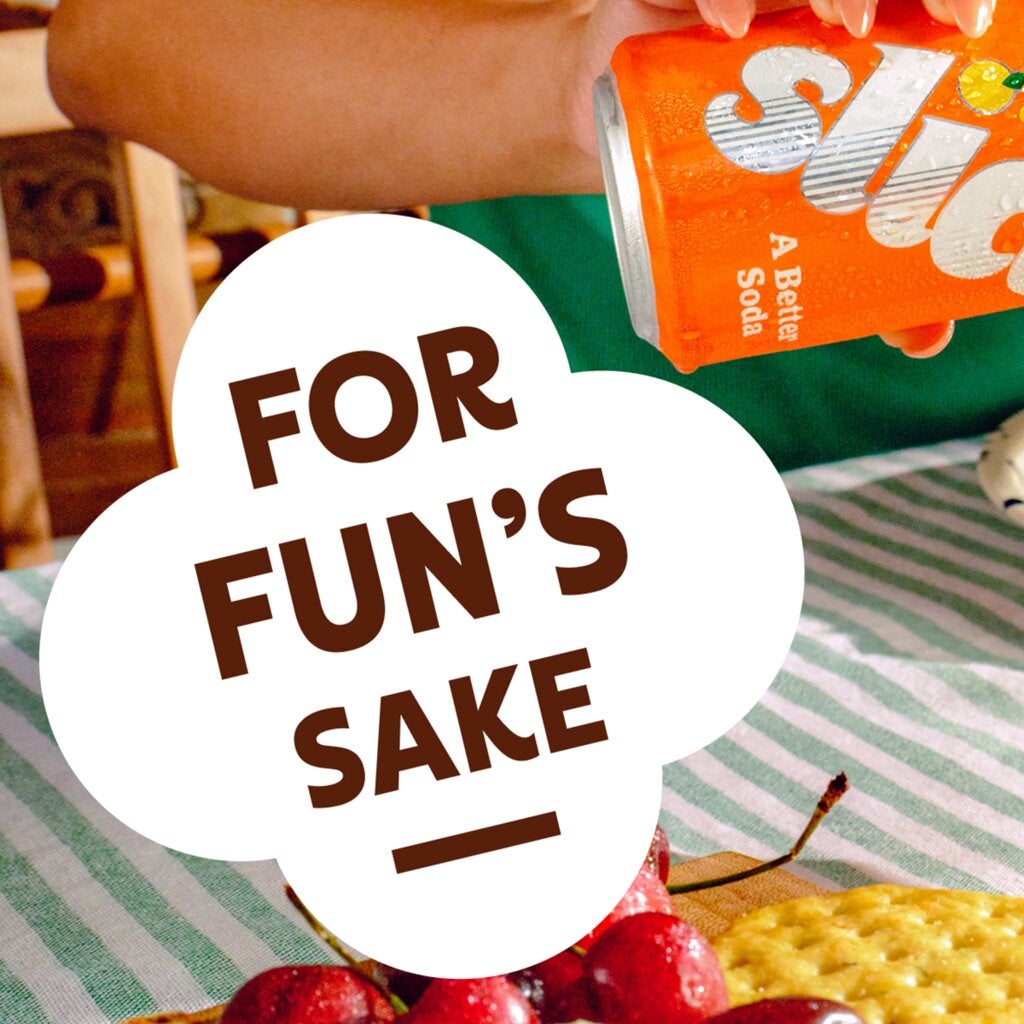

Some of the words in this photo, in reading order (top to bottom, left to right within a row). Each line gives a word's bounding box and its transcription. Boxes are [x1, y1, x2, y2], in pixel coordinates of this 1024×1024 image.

[769, 232, 798, 260] A
[737, 267, 768, 337] Soda
[774, 266, 803, 341] Better
